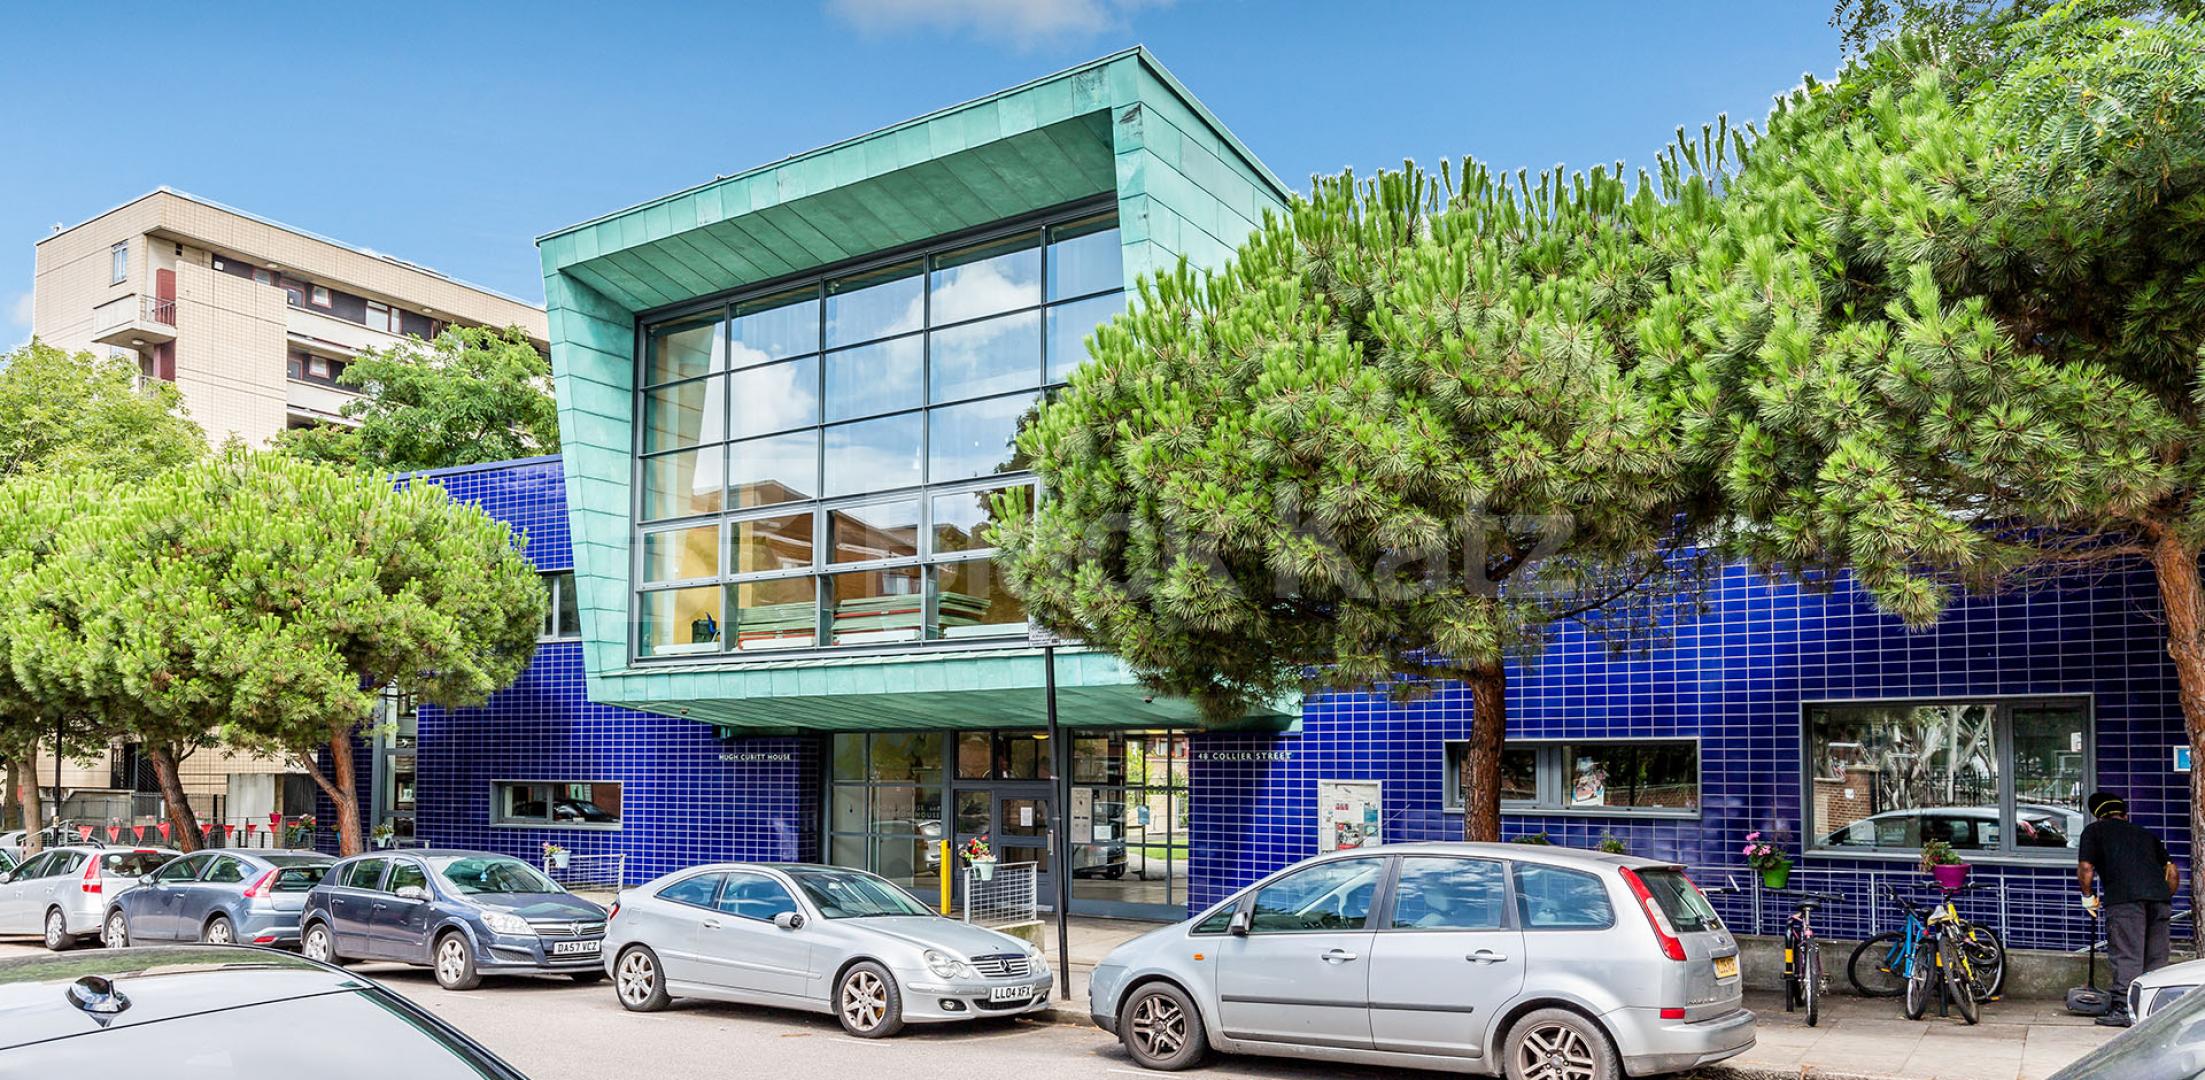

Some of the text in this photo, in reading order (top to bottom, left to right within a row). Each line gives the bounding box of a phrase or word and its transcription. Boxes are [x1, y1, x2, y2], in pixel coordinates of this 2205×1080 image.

[740, 753, 766, 761] CUBITT
[767, 753, 791, 761] HOUSE
[1212, 752, 1253, 760] COLLIER
[1255, 752, 1293, 760] STREET
[557, 941, 597, 952] DA57 VCZ
[995, 985, 1032, 999] LL04 XFX
